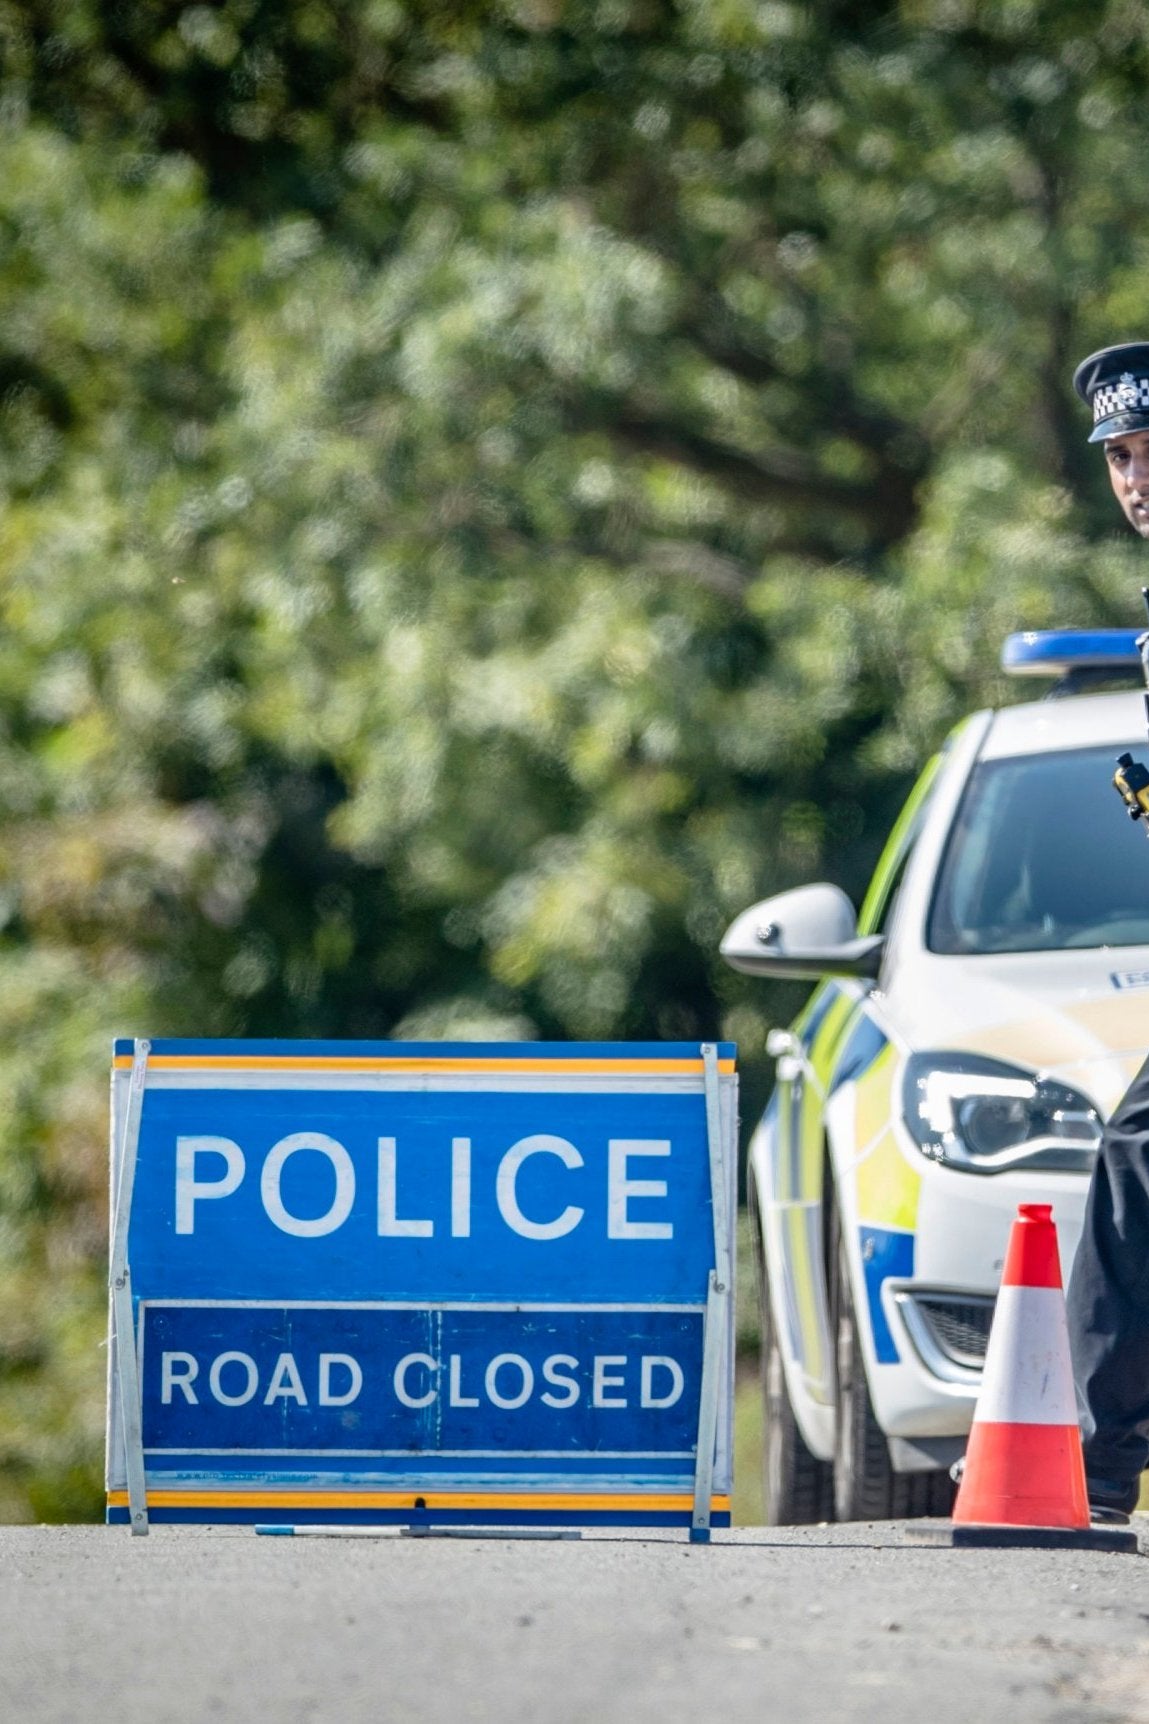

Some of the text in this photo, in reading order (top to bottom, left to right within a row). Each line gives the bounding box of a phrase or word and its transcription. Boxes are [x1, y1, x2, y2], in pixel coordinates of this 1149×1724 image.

[175, 1132, 674, 1240] POLICE
[160, 1351, 686, 1409] ROAD CLOSED
